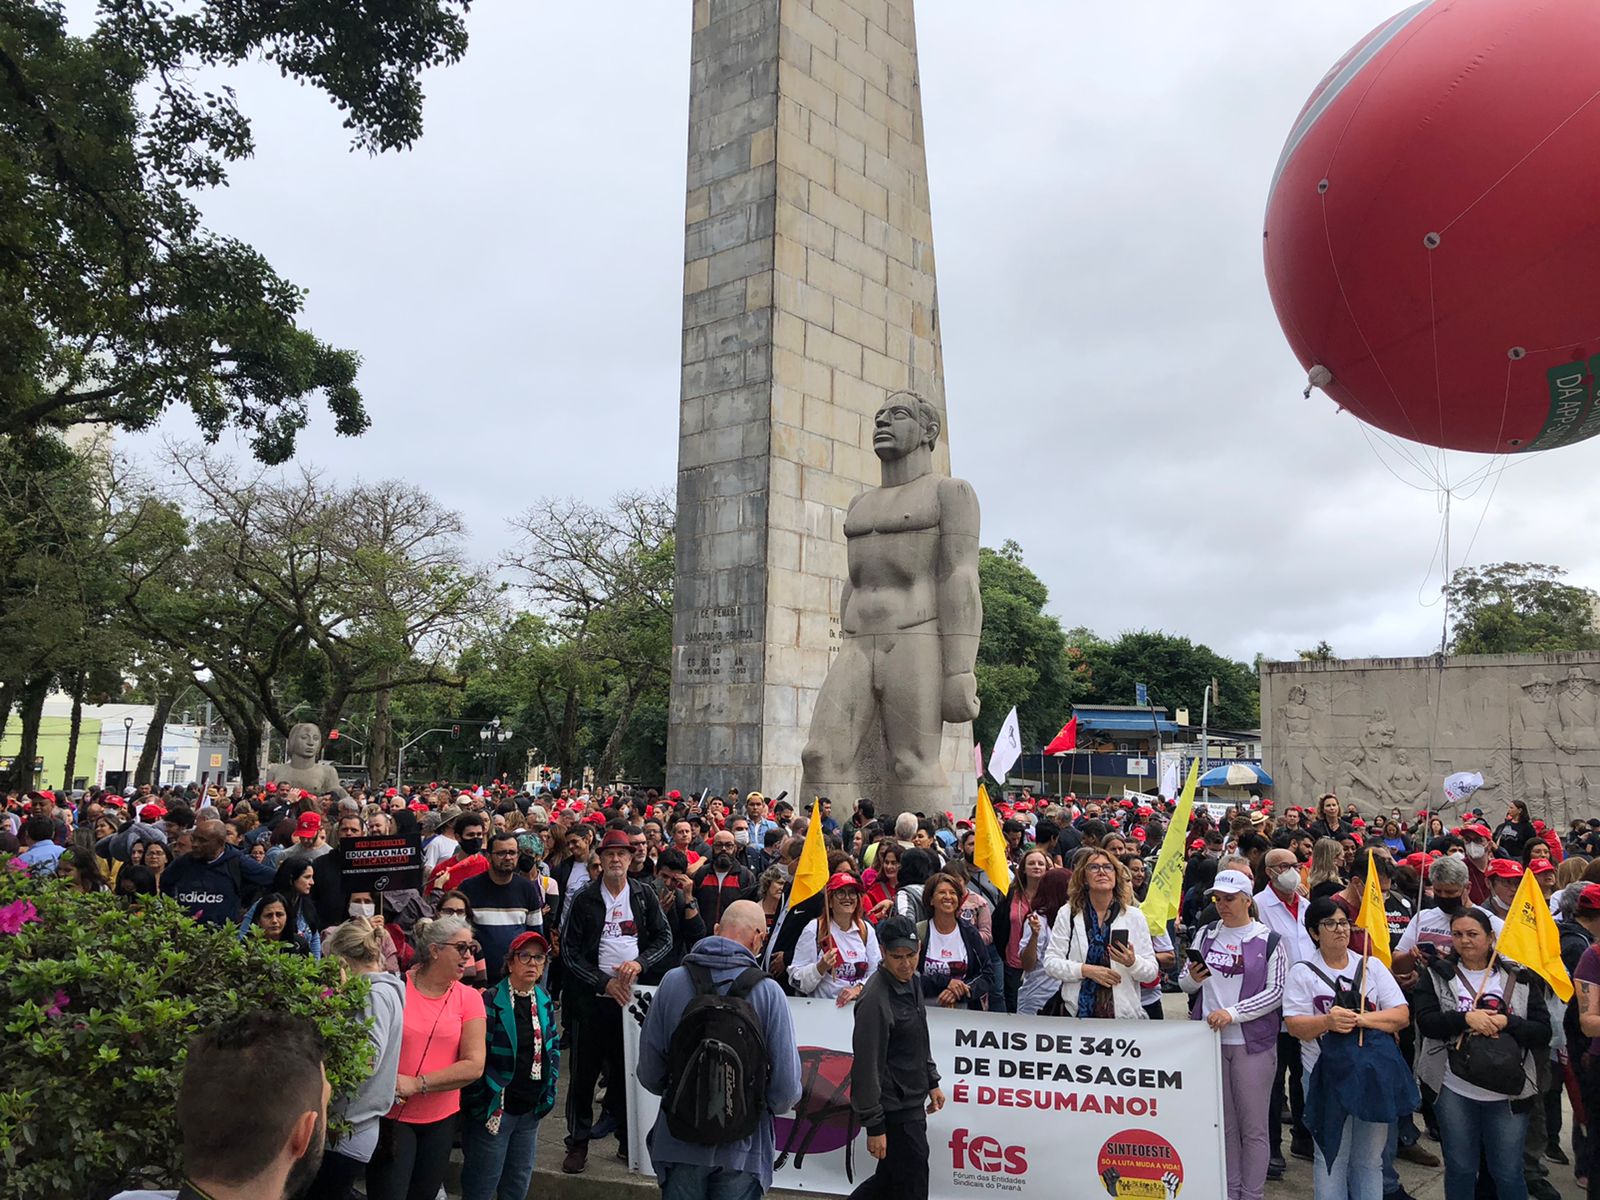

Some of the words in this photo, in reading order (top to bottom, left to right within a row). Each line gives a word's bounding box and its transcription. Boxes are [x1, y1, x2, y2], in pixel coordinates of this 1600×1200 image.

[1556, 373, 1583, 400] DA
[346, 849, 390, 859] EDUCAÇÃO
[391, 847, 408, 856] NÃO
[179, 891, 224, 903] adidas
[955, 1028, 1028, 1051] MAIS
[1035, 1033, 1073, 1054] DE
[1078, 1037, 1142, 1059] 34%
[954, 1056, 990, 1076] DE
[998, 1059, 1183, 1090] DEFASAGEM
[952, 1079, 970, 1103] É
[977, 1086, 1158, 1117] DESUMANO!
[948, 1128, 1029, 1175] fes
[1107, 1142, 1172, 1159] SINTEOESTE
[1135, 1161, 1155, 1169] MUDA
[1161, 1163, 1180, 1171] VIDA!
[953, 1171, 975, 1180] Fórum
[976, 1174, 990, 1182] das
[991, 1174, 1026, 1185] Entidades
[953, 1179, 984, 1188] Sindicais
[985, 1181, 995, 1189] do
[996, 1182, 1022, 1192] Paraná
